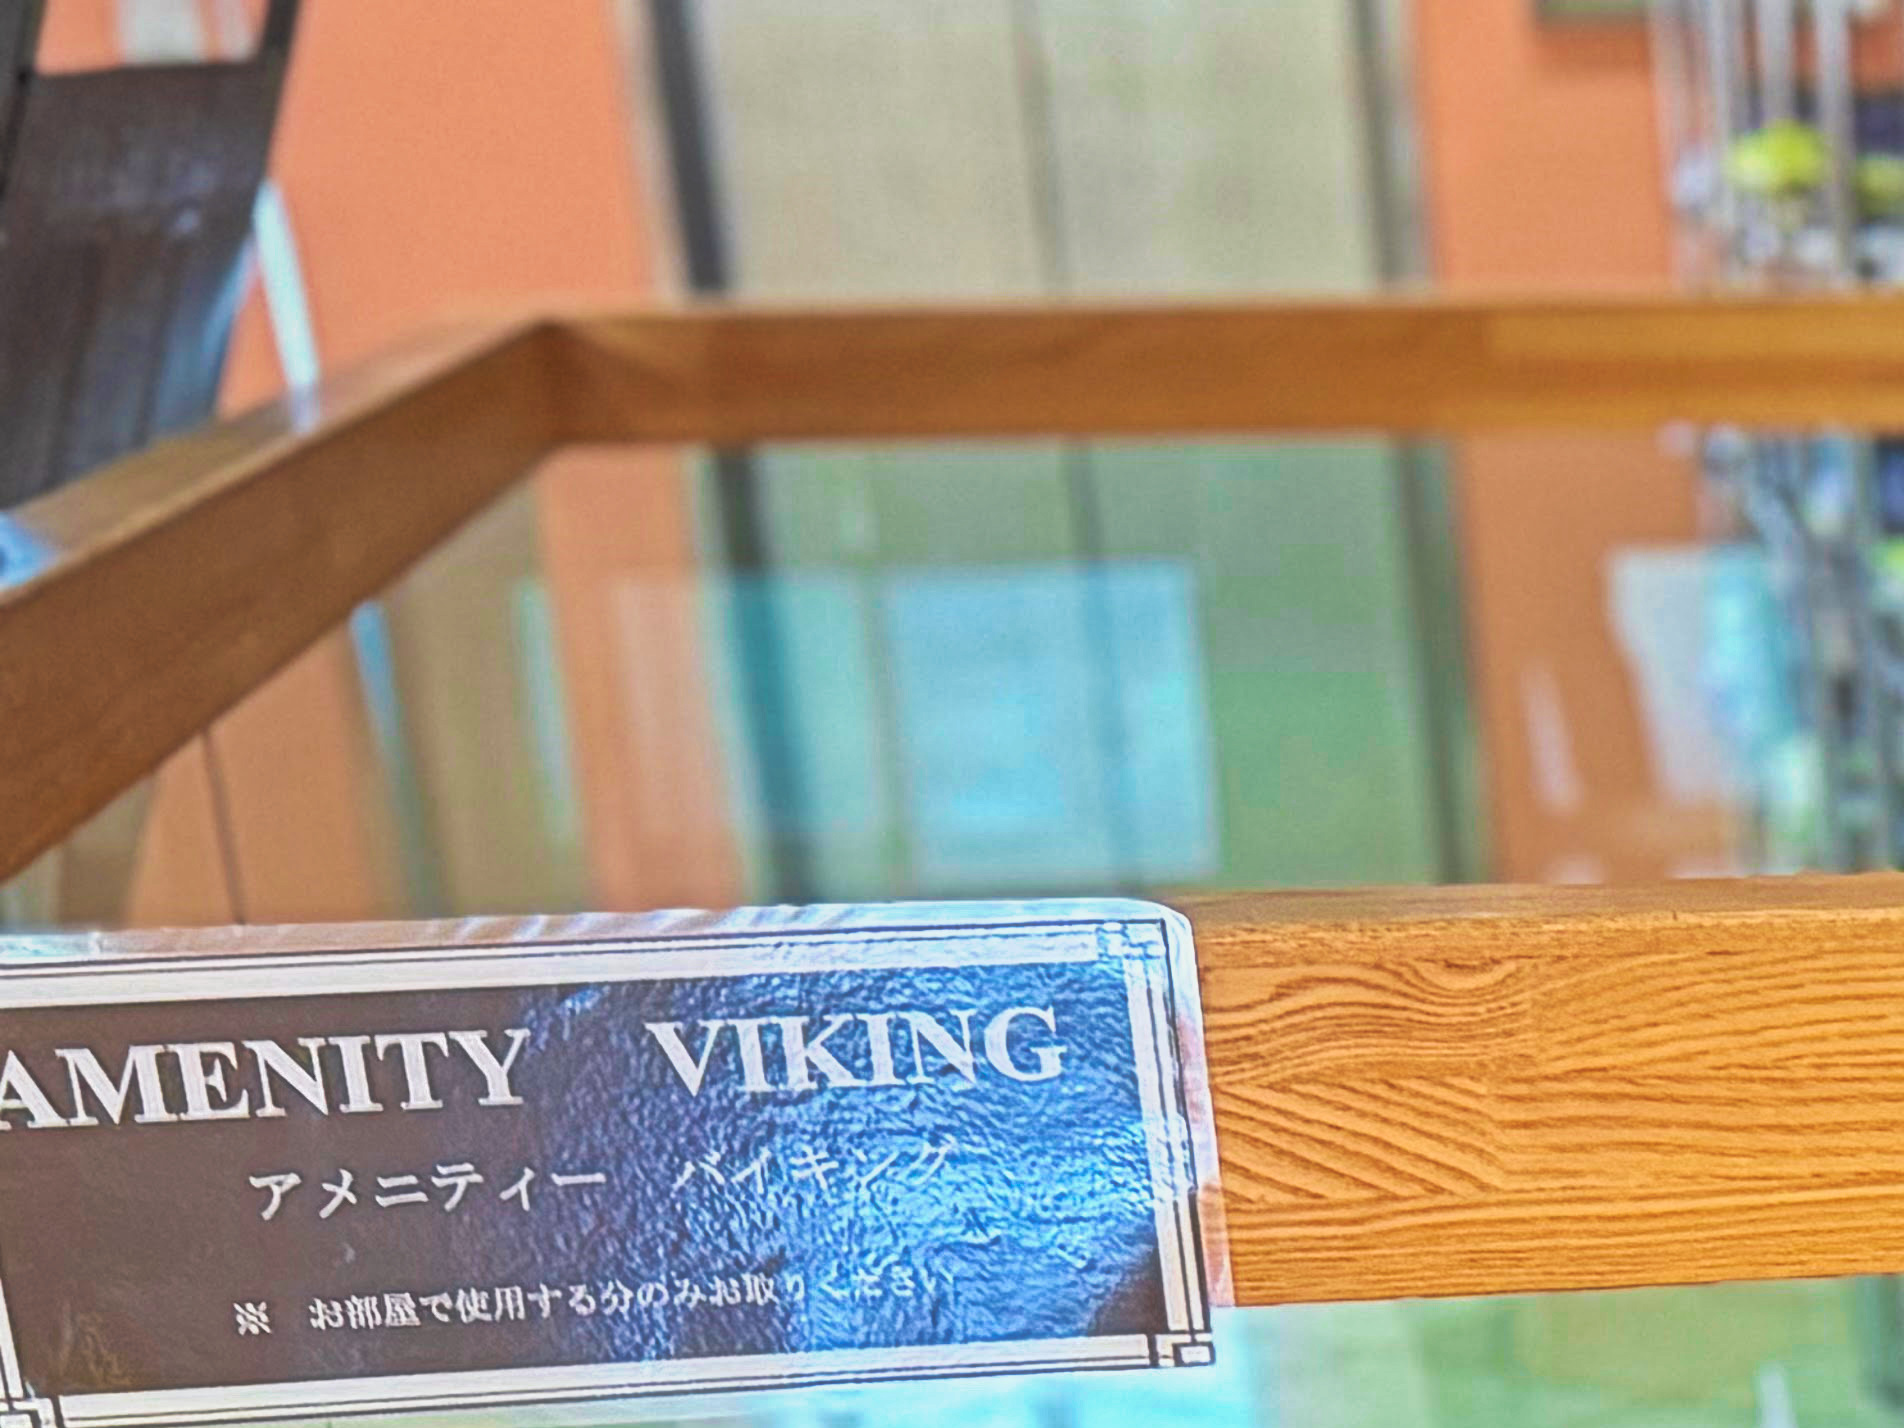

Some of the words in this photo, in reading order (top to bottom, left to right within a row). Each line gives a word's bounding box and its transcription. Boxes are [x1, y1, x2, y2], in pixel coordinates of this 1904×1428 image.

[0, 1028, 531, 1131] AMENITY
[646, 1004, 1067, 1098] VIKING
[249, 1162, 607, 1220] アメニティー
[672, 1134, 959, 1197] バイキング
